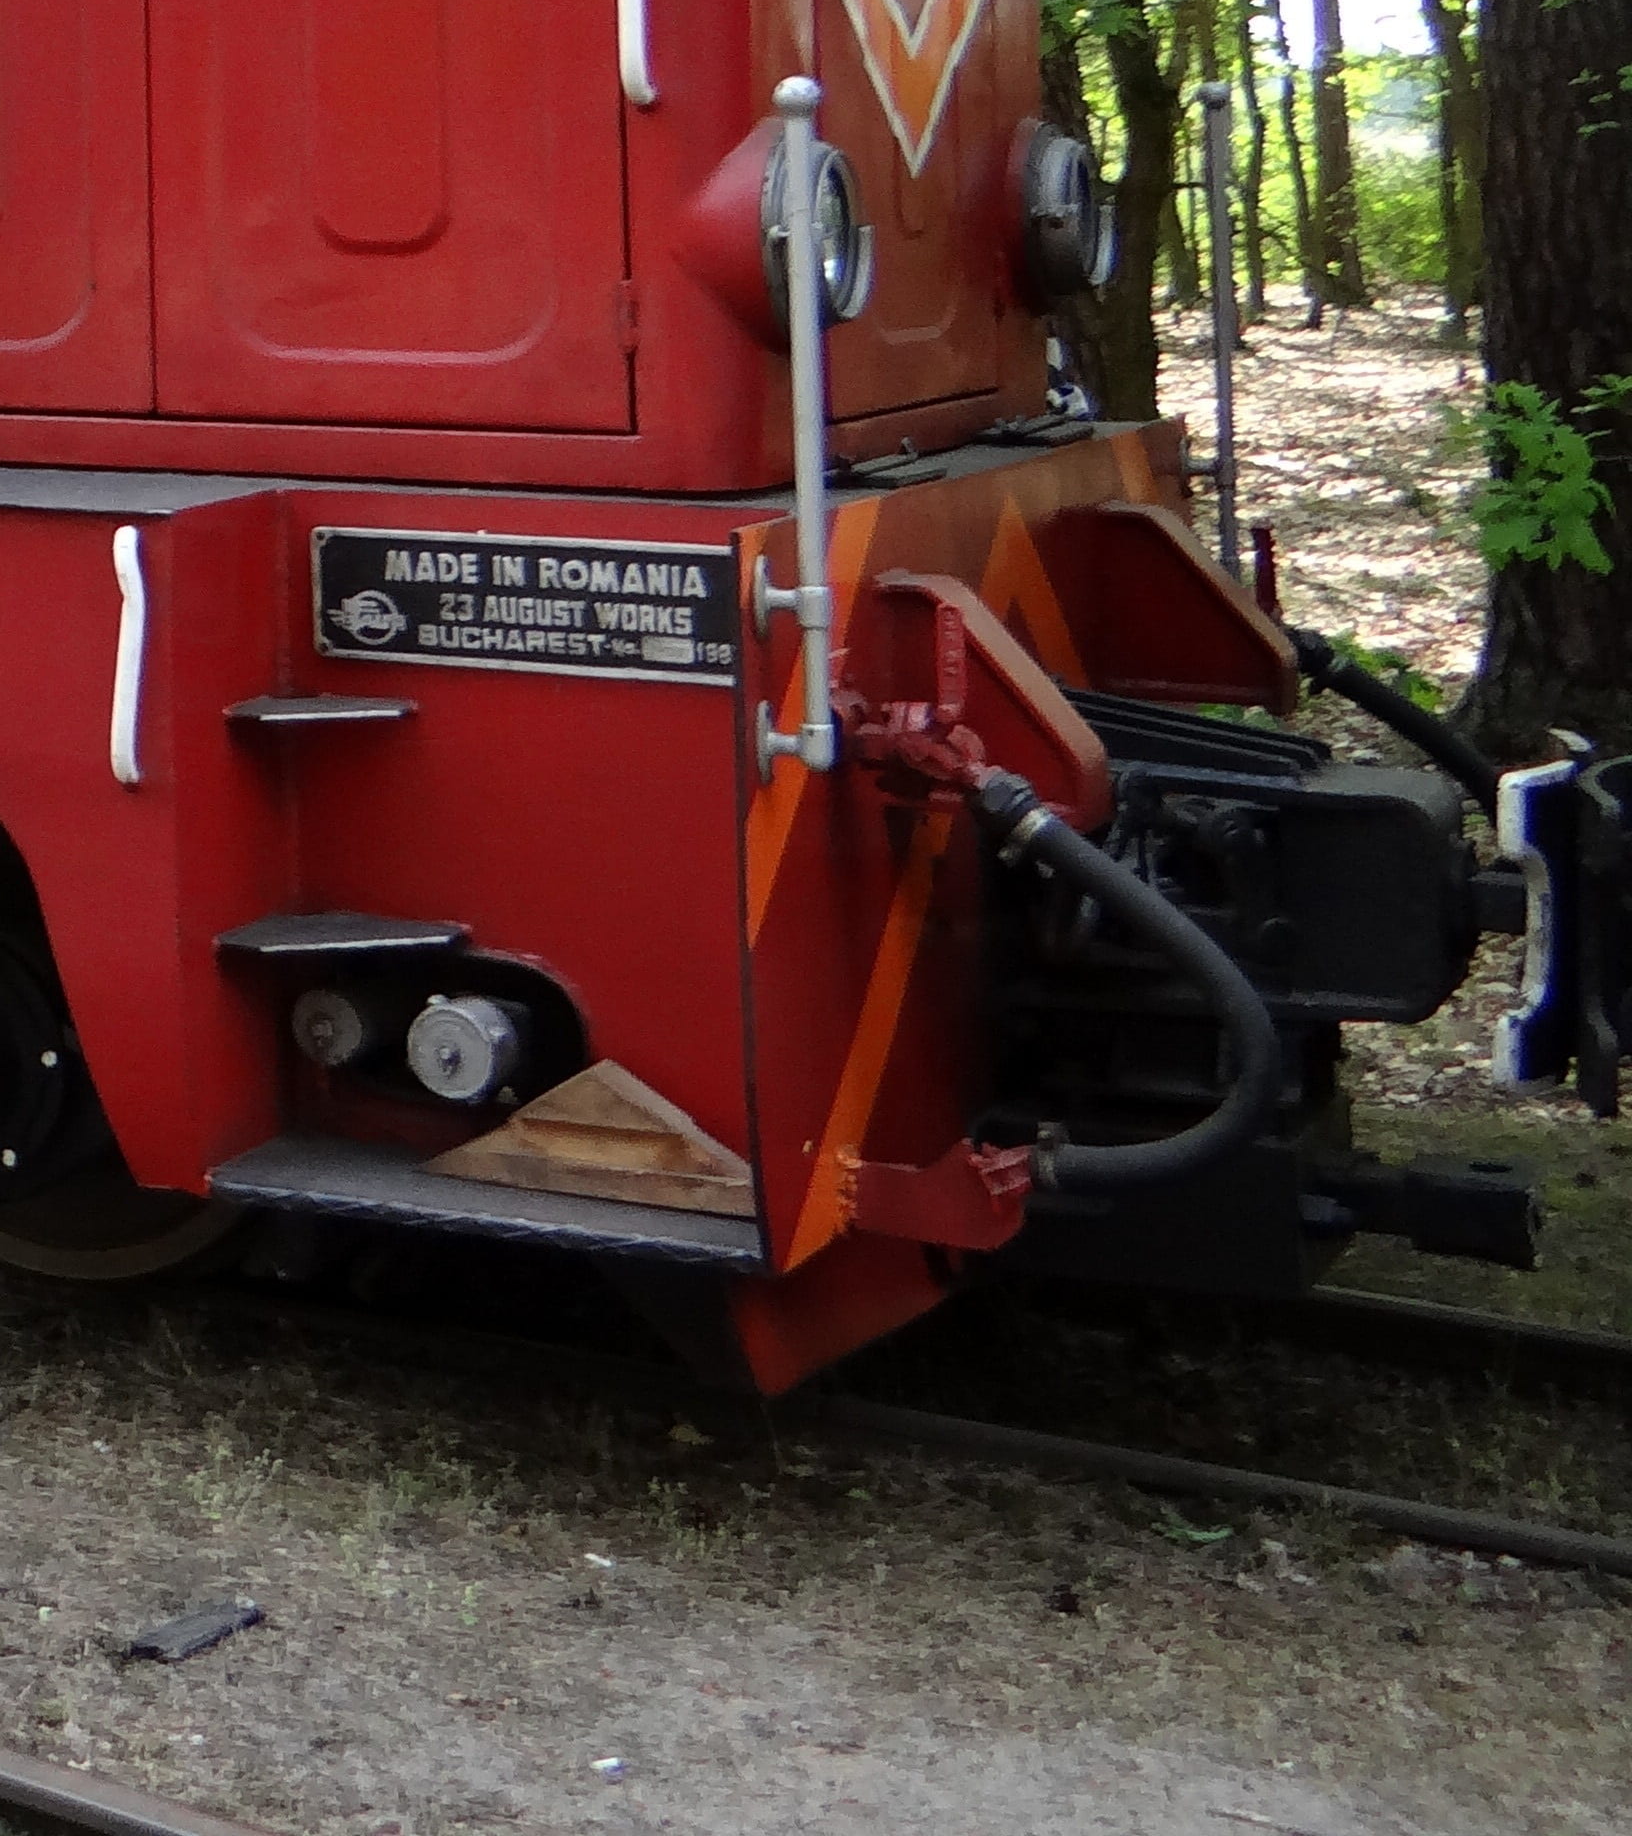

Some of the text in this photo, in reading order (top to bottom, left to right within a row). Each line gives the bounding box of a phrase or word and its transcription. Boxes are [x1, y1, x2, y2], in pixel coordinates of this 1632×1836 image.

[384, 549, 707, 598] MADE IN ROMANIA
[439, 592, 475, 622] 23
[483, 595, 585, 628] AUGUST
[593, 601, 693, 635] WORKS
